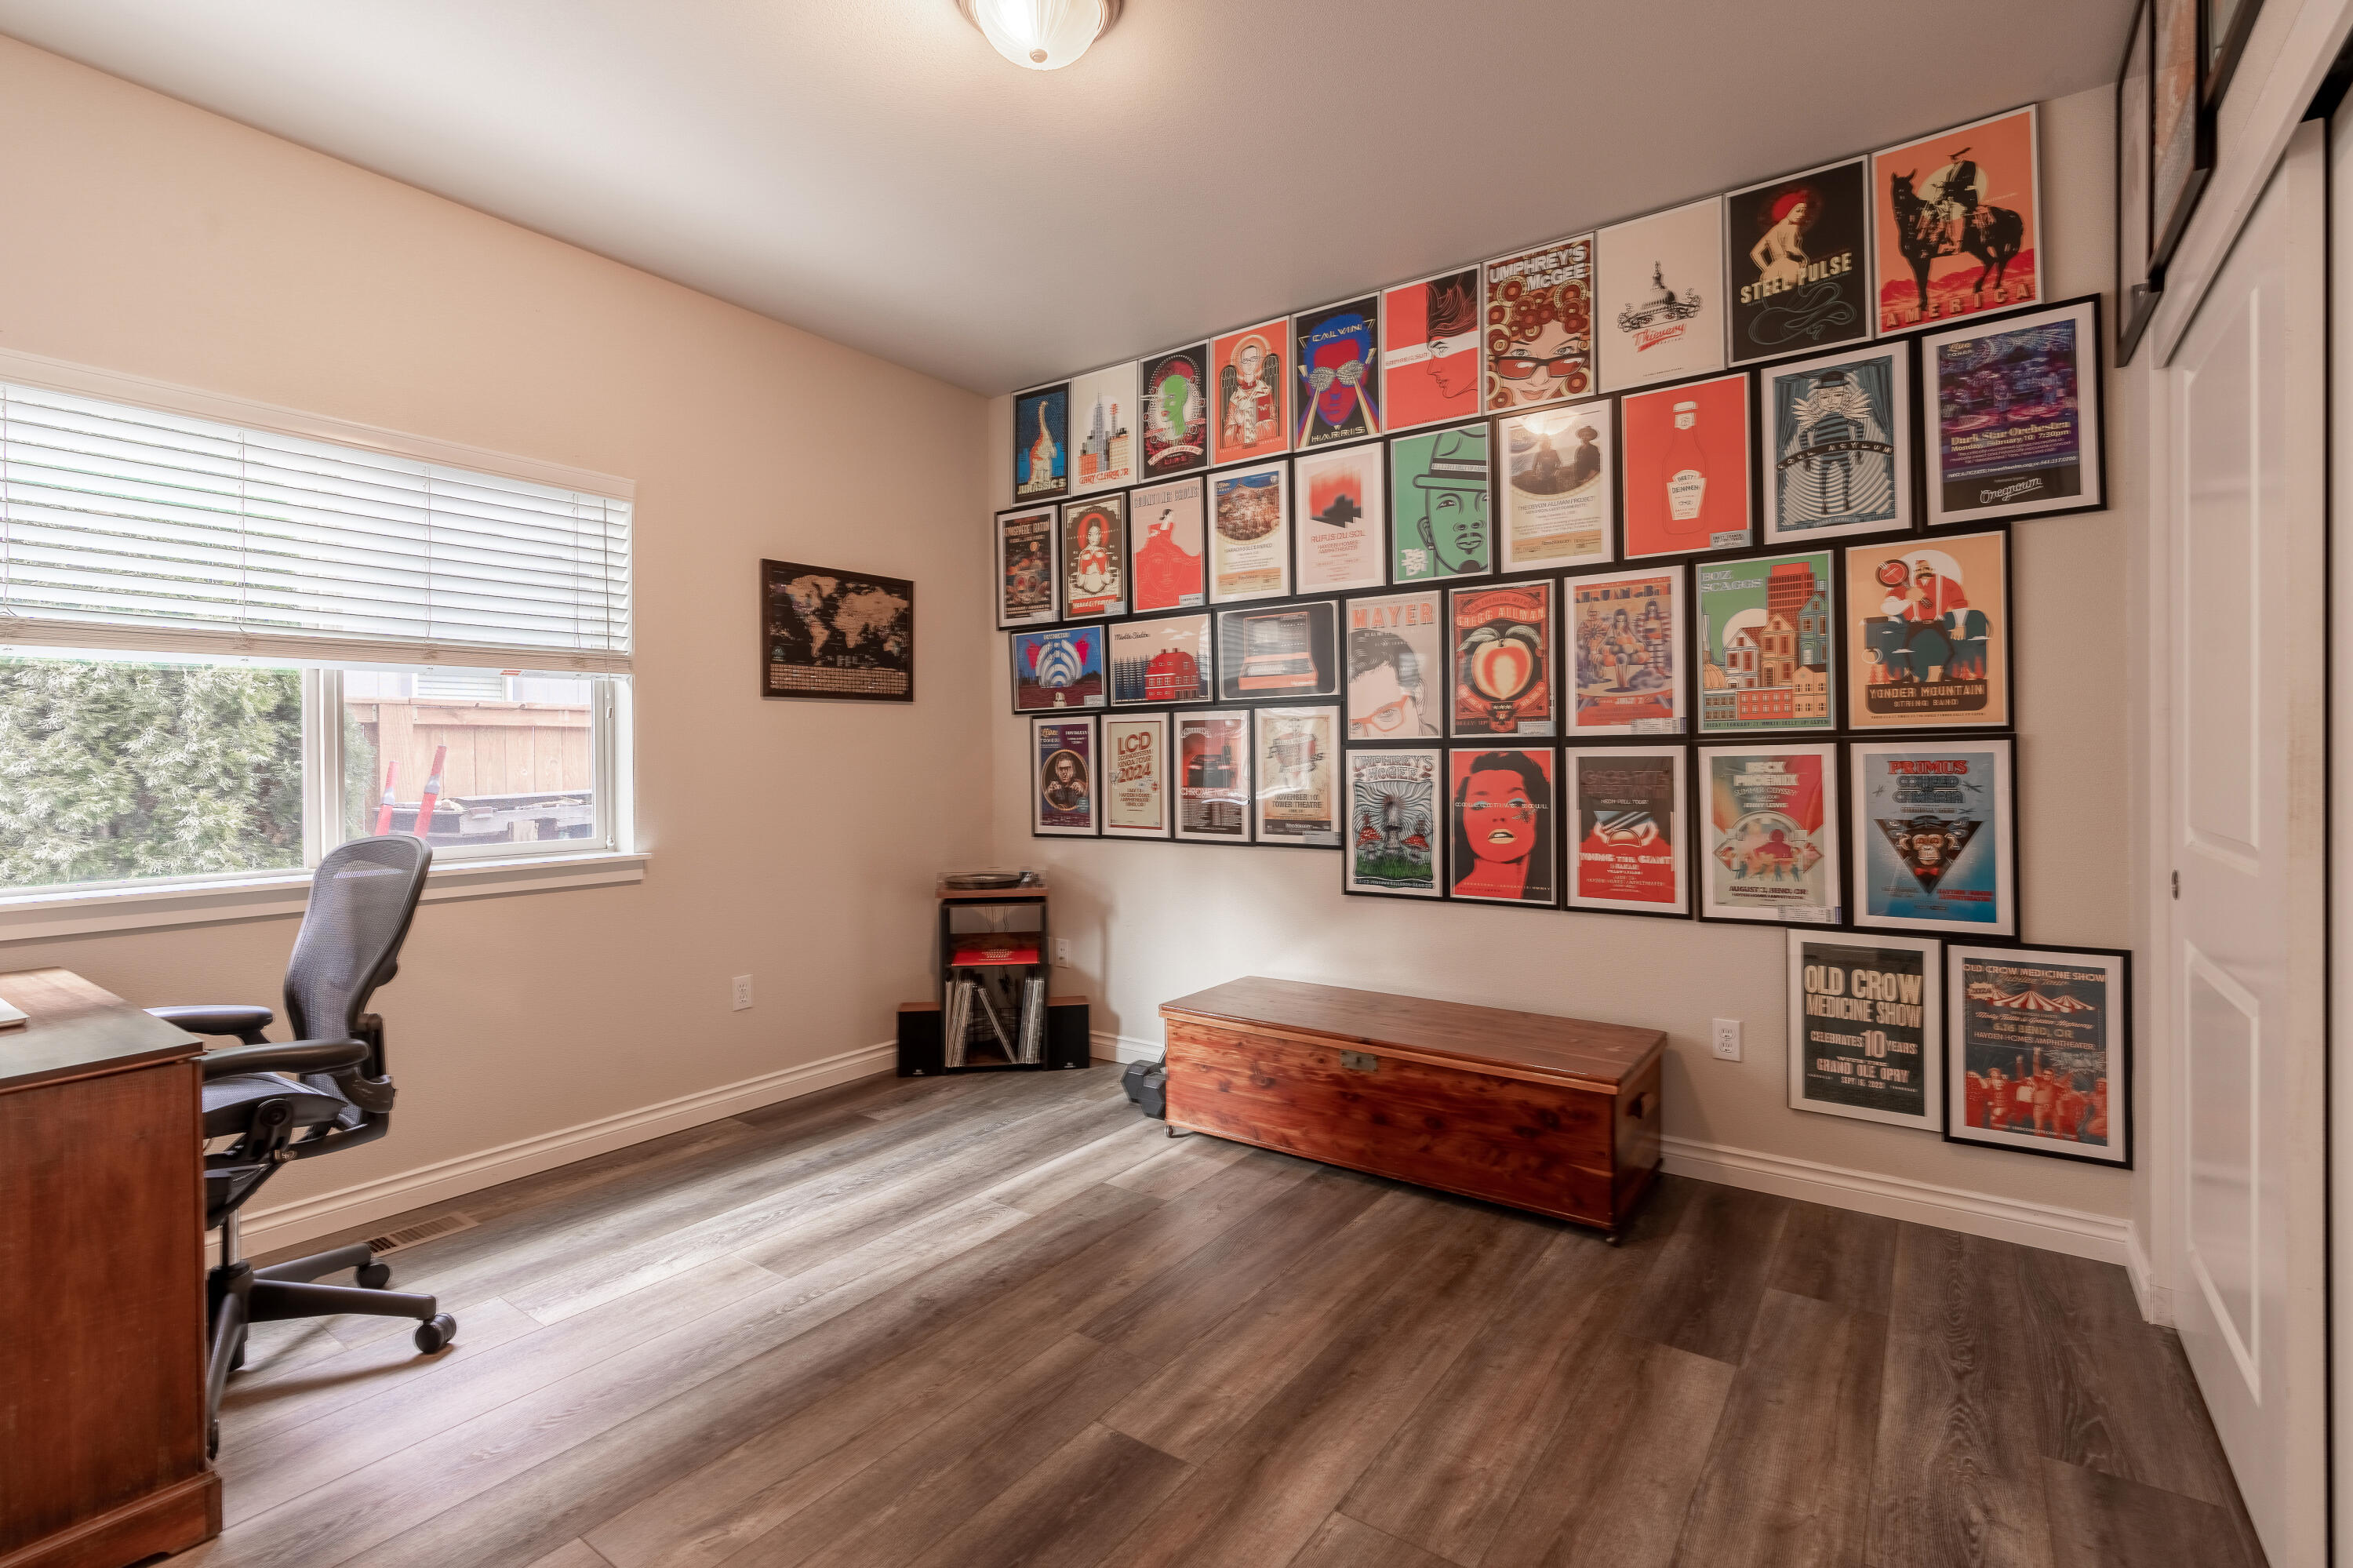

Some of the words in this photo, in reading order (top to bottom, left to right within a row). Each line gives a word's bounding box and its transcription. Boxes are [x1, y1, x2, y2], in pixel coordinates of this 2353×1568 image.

[1489, 246, 1587, 283] UMPHREY'S
[1740, 277, 1792, 304] STEEL
[1798, 252, 1853, 286] PULSE
[1886, 283, 2030, 328] AMERICA
[1312, 324, 1362, 342] CALVIN
[1633, 322, 1686, 347] Thievery
[1311, 426, 1365, 442] HARRIS
[1951, 434, 1979, 446] Dark
[1982, 431, 2006, 440] Star
[2009, 421, 2071, 436] Orchestra
[1951, 442, 1984, 453] Monday,
[1987, 437, 2021, 447] February
[1079, 475, 1096, 485] GARY
[1096, 470, 1119, 481] CLARK
[1174, 486, 1200, 501] CROWS
[1700, 570, 1733, 582] BOZ
[1700, 578, 1764, 593] SCAGGS
[1352, 603, 1434, 630] MAYER
[1457, 609, 1493, 627] GREGG
[1497, 607, 1544, 622] ALLMAN
[1869, 687, 1917, 699] YONDER
[1922, 684, 1985, 697] MOUNTAIN
[1894, 699, 1929, 708] STRING
[1117, 731, 1153, 755] LCD
[1117, 748, 1154, 762] SOUNDSYSTEM
[1351, 755, 1435, 773] UMPHREY'S
[1118, 762, 1152, 783] 2024
[1888, 760, 1969, 775] PRIMUS
[1962, 964, 1983, 973] OLD
[1985, 966, 2017, 975] CROW
[2020, 968, 2071, 980] MEDICINE
[2071, 973, 2106, 983] SHOW
[1804, 965, 1845, 996] OLD
[1851, 969, 1923, 1005] CROW
[1806, 993, 1875, 1023] MEDICINE
[1876, 1001, 1923, 1028] SHOW
[1974, 1031, 2003, 1040] HAYDEN
[2006, 1034, 2035, 1044] HOMES
[2035, 1036, 2097, 1050] AMPHITHEATER
[2053, 1028, 2075, 1039] OR
[1810, 1030, 1865, 1048] CELEBRATES
[1860, 1029, 1887, 1058] 10
[1886, 1039, 1918, 1055] YEARS
[1816, 1057, 1854, 1075] GRAND
[1857, 1063, 1878, 1079] OLE
[1880, 1067, 1910, 1083] OPRY
